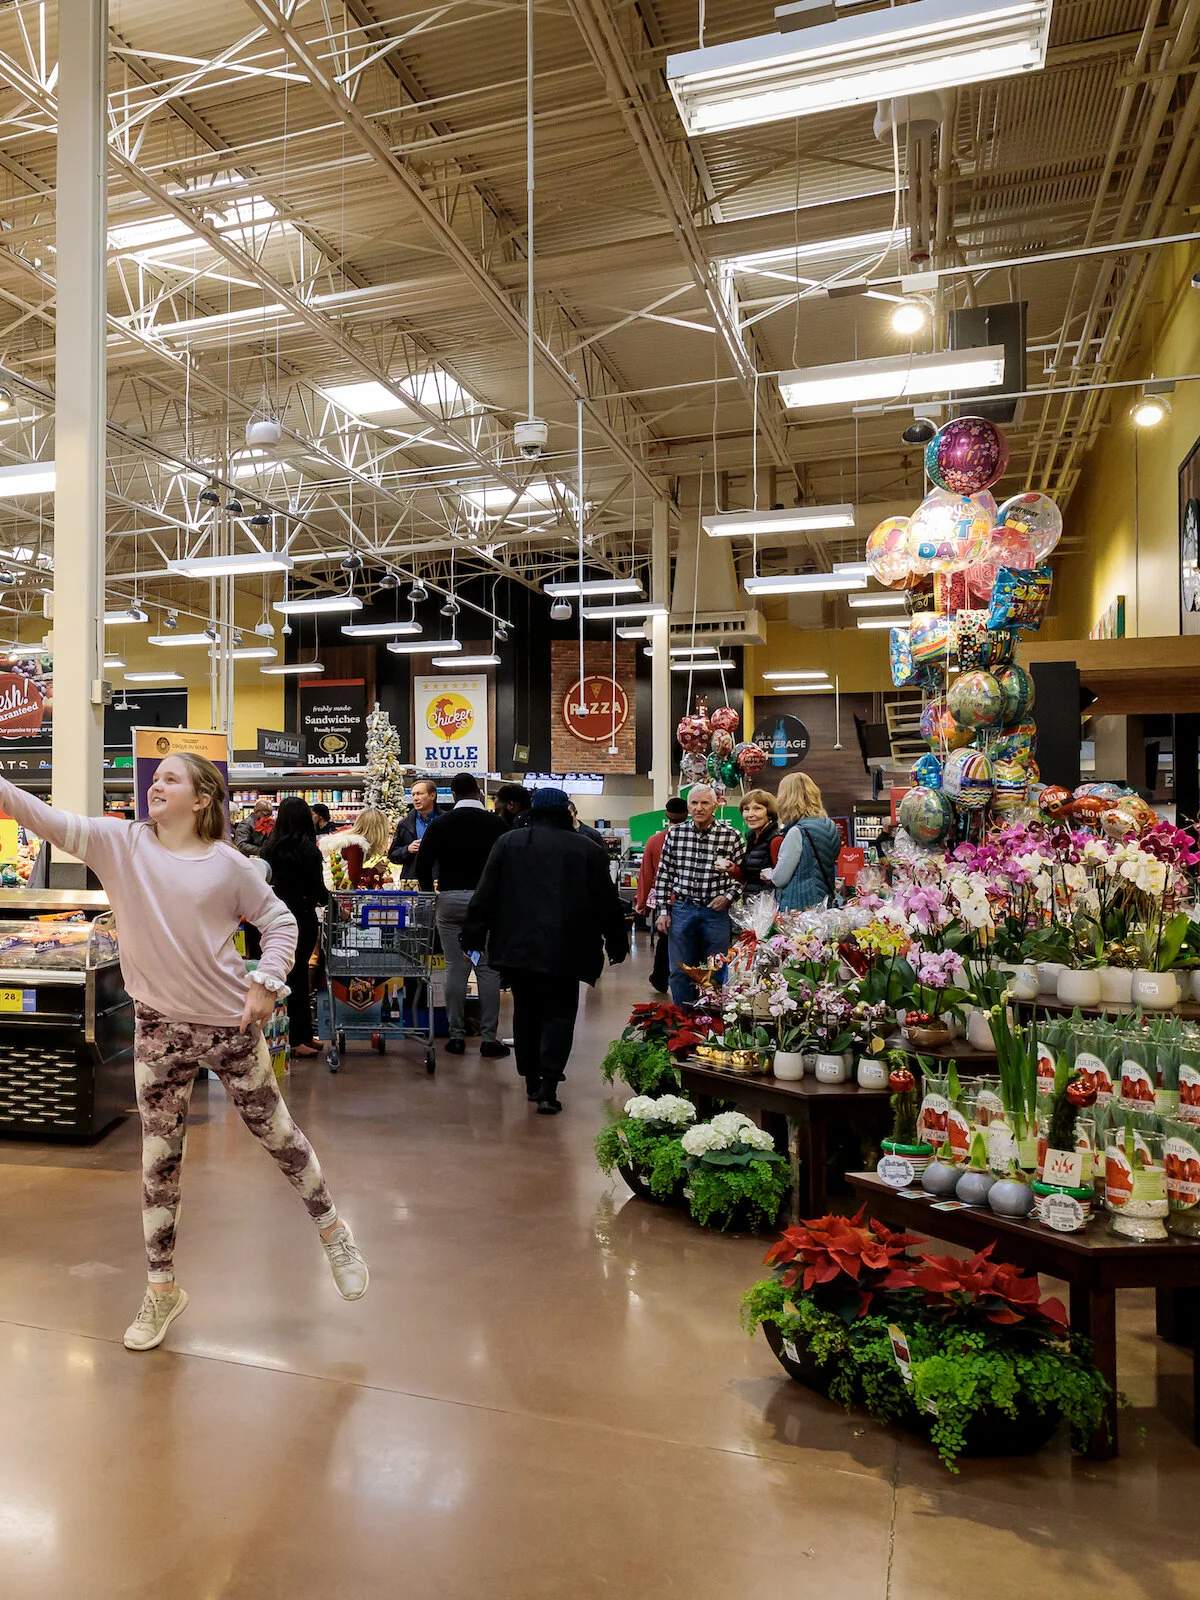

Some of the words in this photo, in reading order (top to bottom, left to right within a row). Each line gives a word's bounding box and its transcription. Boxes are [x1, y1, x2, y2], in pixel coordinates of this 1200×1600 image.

[312, 705, 333, 713] freshly
[569, 701, 622, 716] PZZA
[304, 714, 361, 725] Sandwiches
[426, 707, 474, 731] Chicken
[758, 739, 807, 749] BEVERAGE
[307, 753, 335, 765] Boar's
[335, 752, 361, 764] Head
[425, 746, 478, 760] RULE
[426, 761, 439, 769] THE
[440, 760, 478, 768] ROOST
[1077, 1058, 1101, 1068] TULIPS
